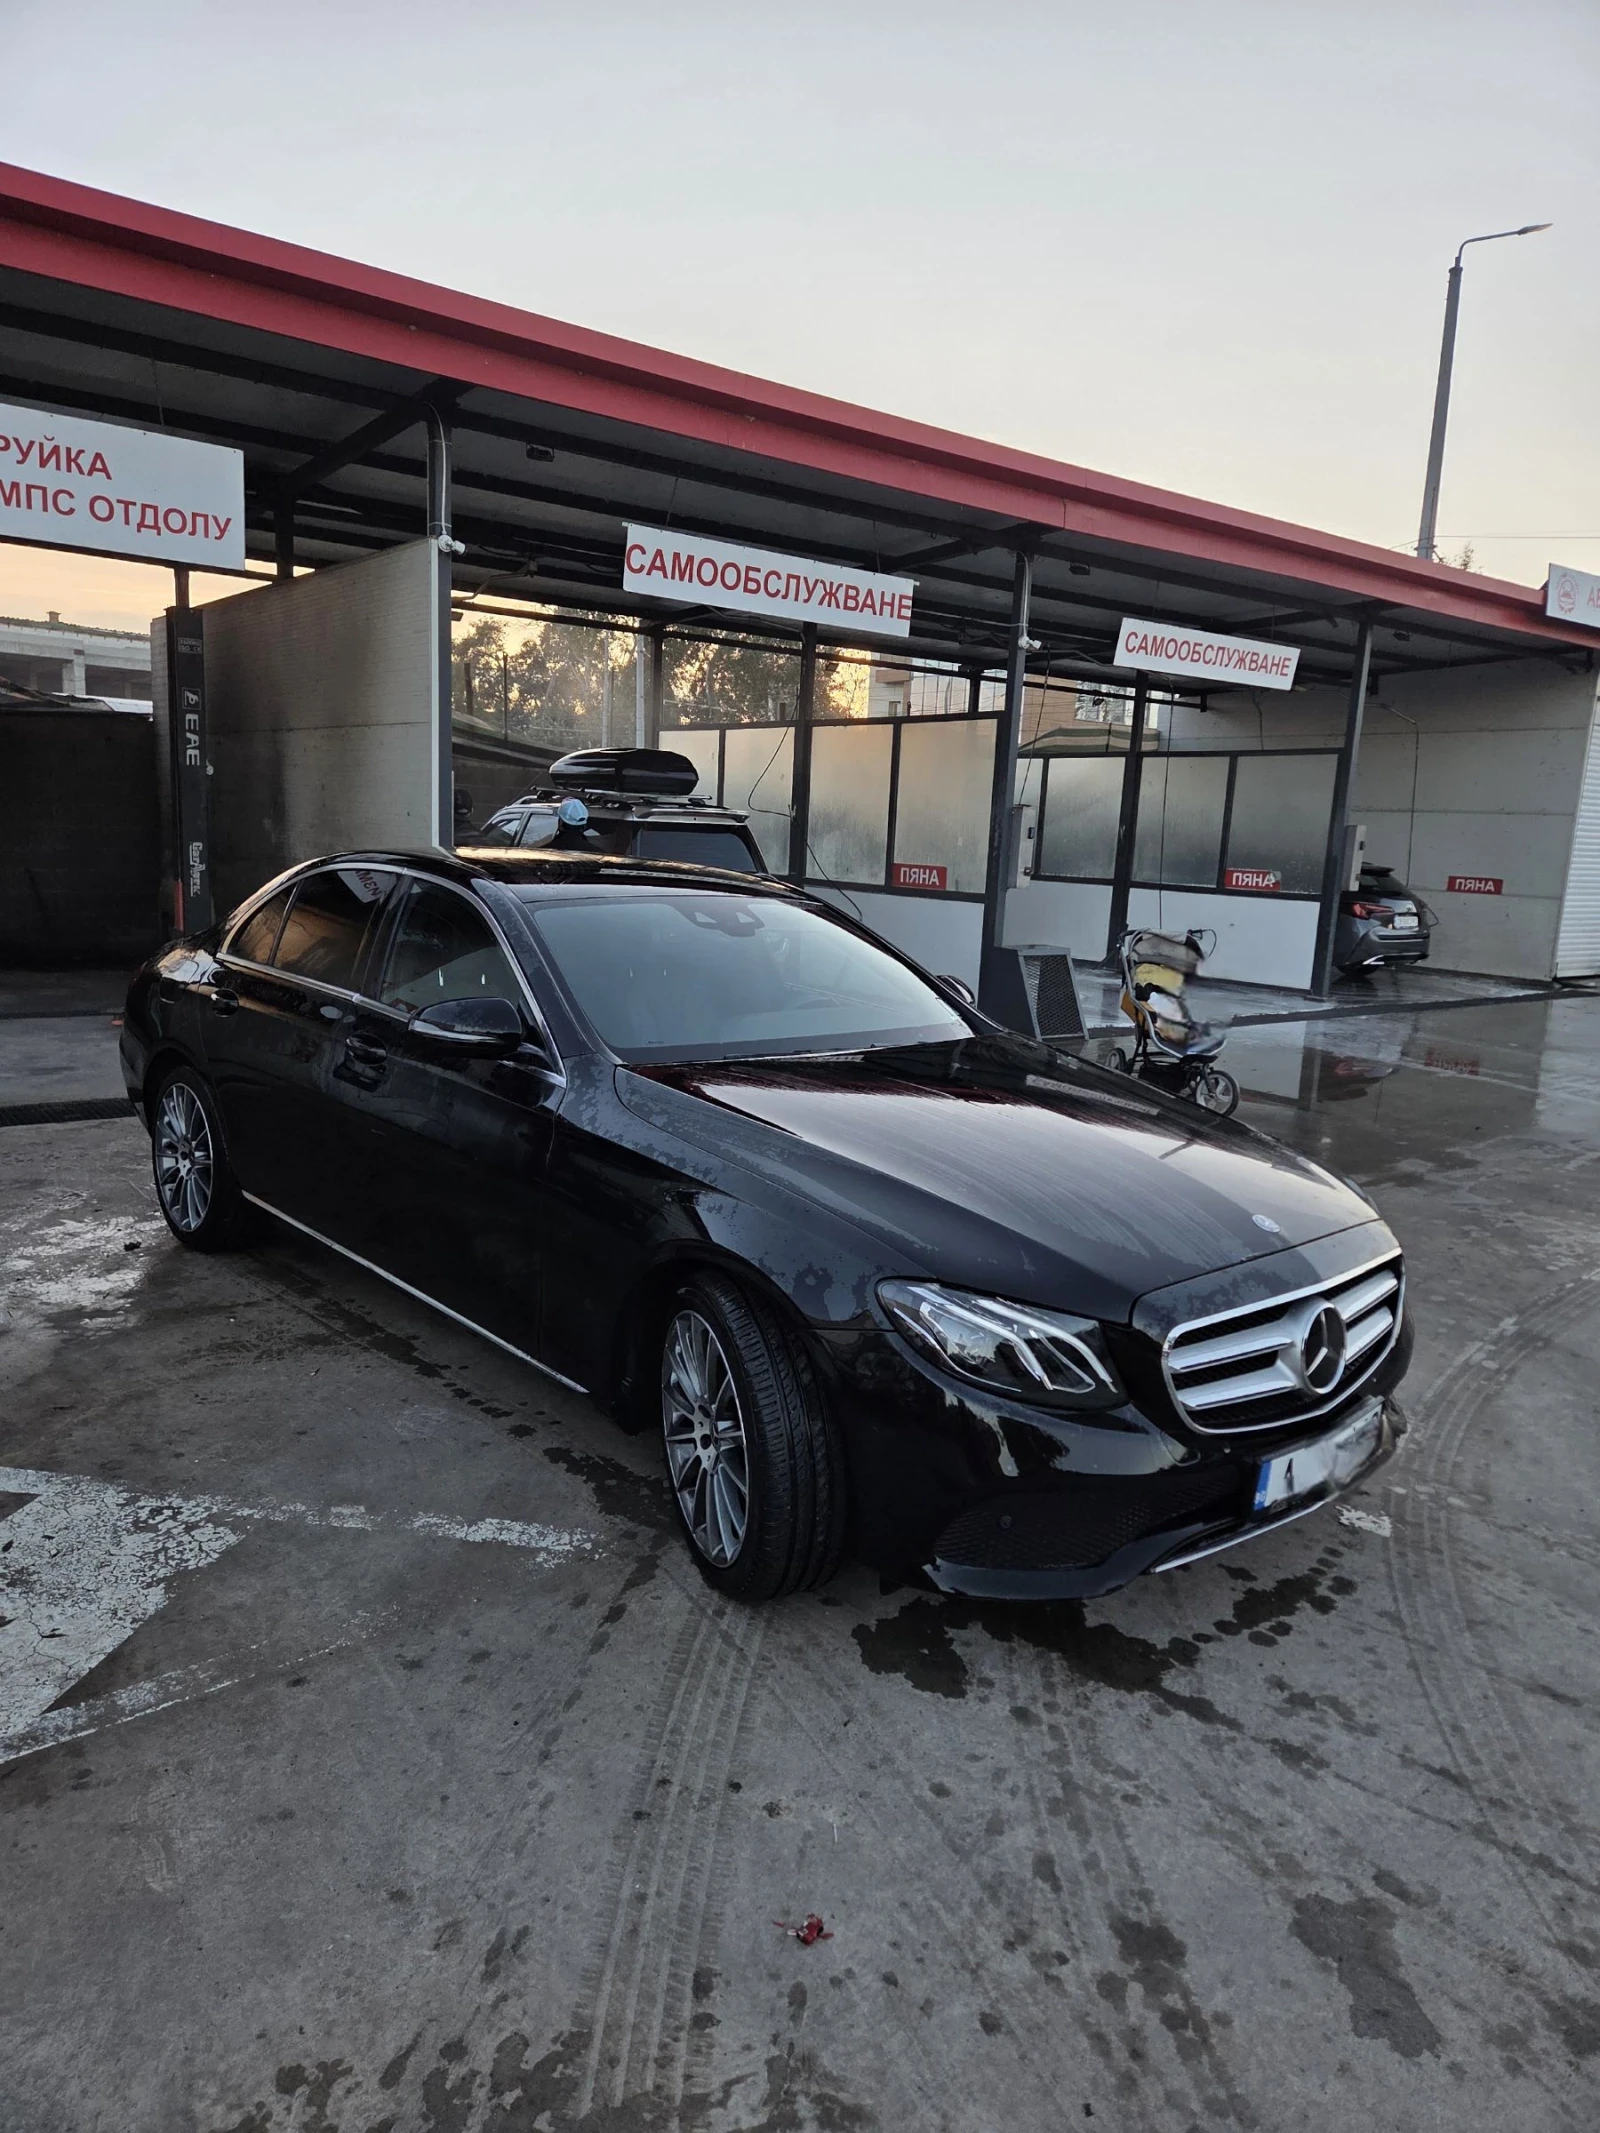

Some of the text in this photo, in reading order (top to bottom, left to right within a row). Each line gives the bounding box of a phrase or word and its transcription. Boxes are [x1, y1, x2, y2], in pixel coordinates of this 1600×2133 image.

[0, 479, 232, 540] МПС ОТДОЛУ
[625, 543, 913, 621] САМООБСЛУЖВАНЕ
[1125, 631, 1292, 677] САМООБСЛУЖВАНЕ
[185, 713, 200, 766] EAE
[900, 867, 939, 886] ПЯНА
[1232, 872, 1274, 888] ПЯНА
[1455, 878, 1495, 893] ПЯНА
